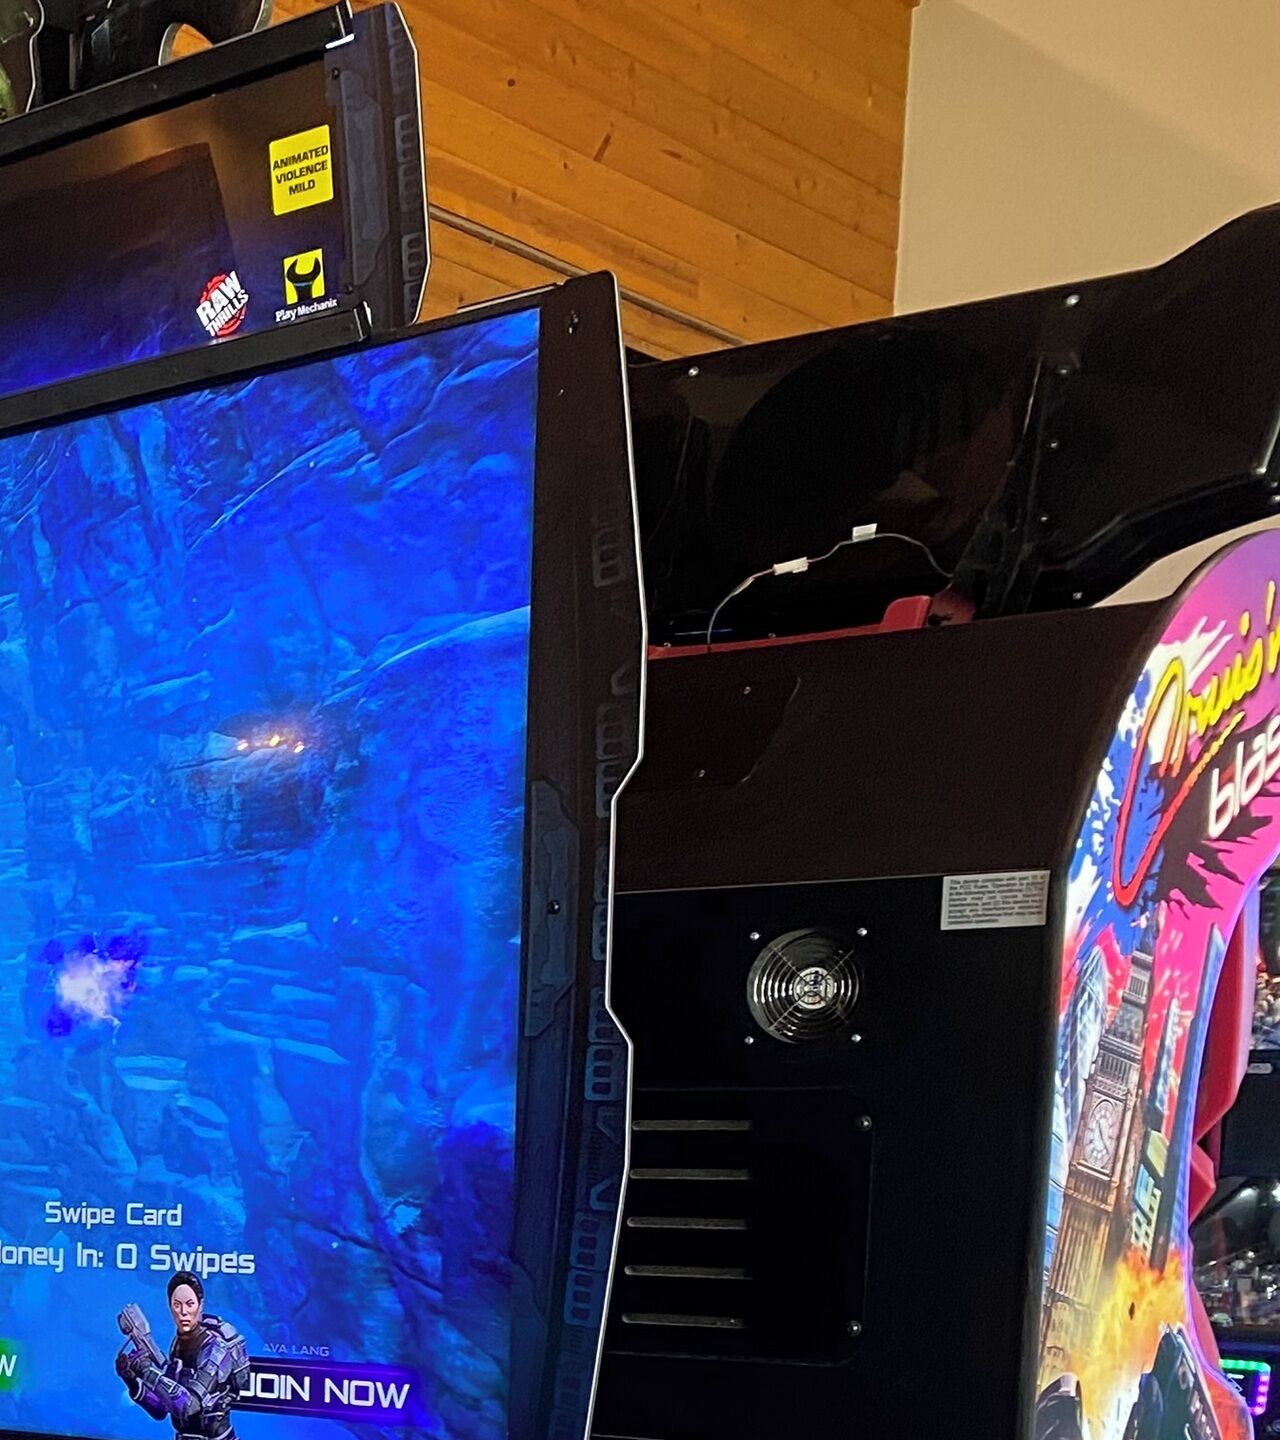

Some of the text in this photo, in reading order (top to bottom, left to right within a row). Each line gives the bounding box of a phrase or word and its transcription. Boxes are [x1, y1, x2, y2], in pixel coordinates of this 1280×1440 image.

[272, 144, 330, 172] ANIMATED
[275, 159, 329, 185] VIOLENCE
[288, 178, 316, 197] MILD
[196, 270, 242, 327] RAW
[275, 297, 338, 323] Play Mechanix
[205, 288, 249, 338] THRILLS
[1208, 712, 1280, 840] blas
[44, 1200, 183, 1228] Swipe Card
[75, 1242, 104, 1269] In:
[149, 1241, 257, 1280] Swipes
[262, 1343, 330, 1357] AVA LANG
[239, 1371, 411, 1410] JOIN NOW
